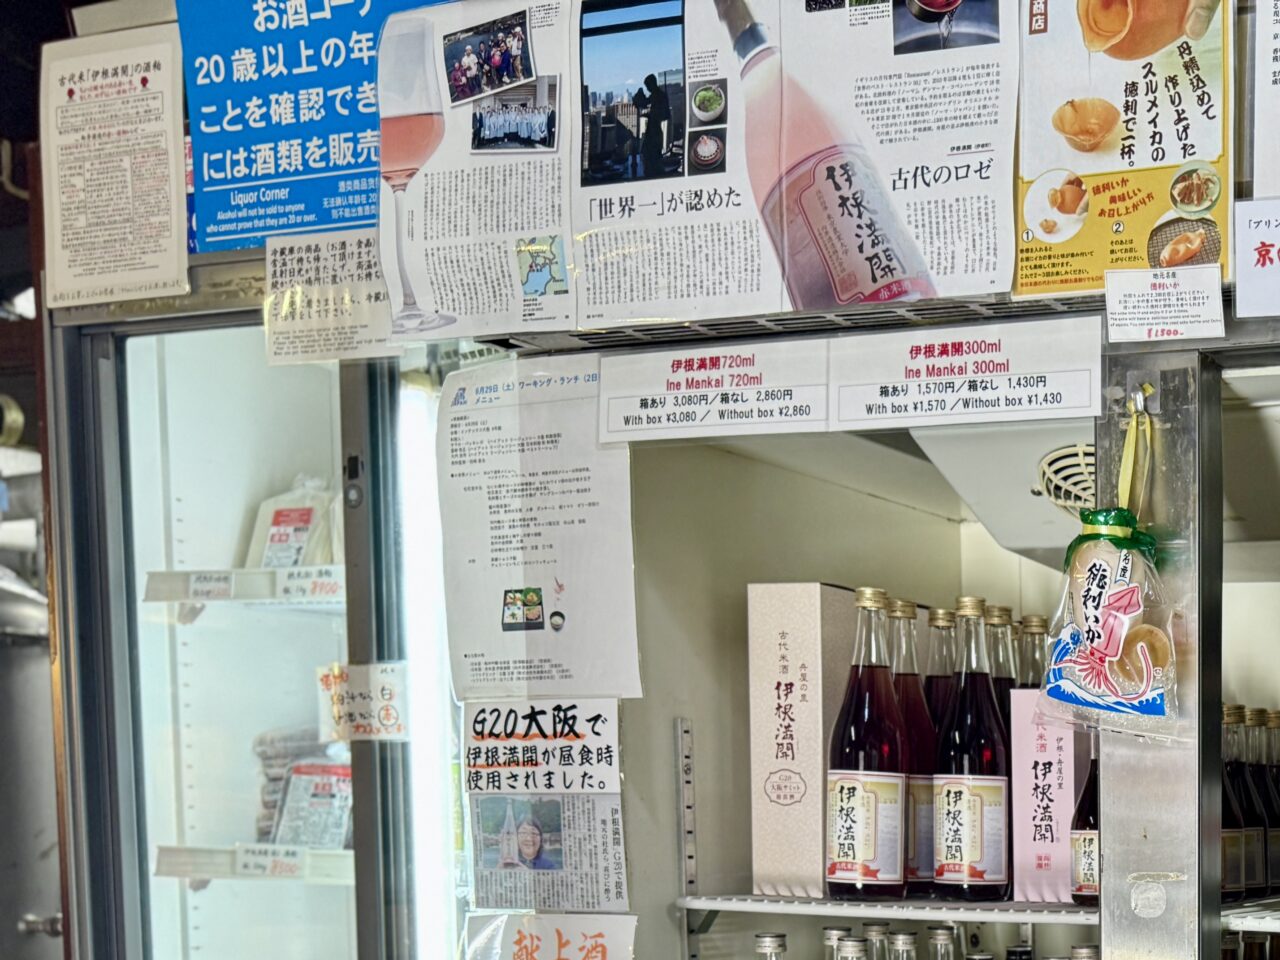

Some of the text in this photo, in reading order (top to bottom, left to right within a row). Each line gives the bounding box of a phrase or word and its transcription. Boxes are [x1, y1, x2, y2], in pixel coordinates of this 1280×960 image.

[1176, 41, 1216, 120] 丹精込めて
[1120, 80, 1140, 168] 徳利で一杯。
[1141, 61, 1166, 162] スルメイカの
[1164, 75, 1197, 159] 作り上げた
[891, 158, 994, 191] 古代のロゼ
[230, 187, 289, 206] Liquor Corner
[587, 186, 742, 222] 「世界一」が認めた
[909, 339, 1001, 360] 伊根満開300ml
[671, 354, 755, 374] 伊根満開720ml
[905, 358, 1010, 380] Ine Mankai 300ml
[666, 371, 763, 392] Ine Mankai 720ml
[879, 375, 1047, 399] 箱あり 1,430円
[639, 388, 793, 411] 箱あり 2,860円
[866, 392, 1063, 416] With box ¥1,570 box ¥1,430
[623, 404, 811, 427] With box ¥3,080 Without box ¥2,860
[473, 704, 608, 740] G20大阪で
[774, 681, 796, 761] 伊根満開
[466, 744, 613, 768] 伊根満開が昼食時
[467, 770, 606, 791] 使用されました。
[1031, 760, 1054, 844] 伊根満開
[838, 785, 857, 860] 伊根満開
[945, 789, 964, 862] 伊根満開
